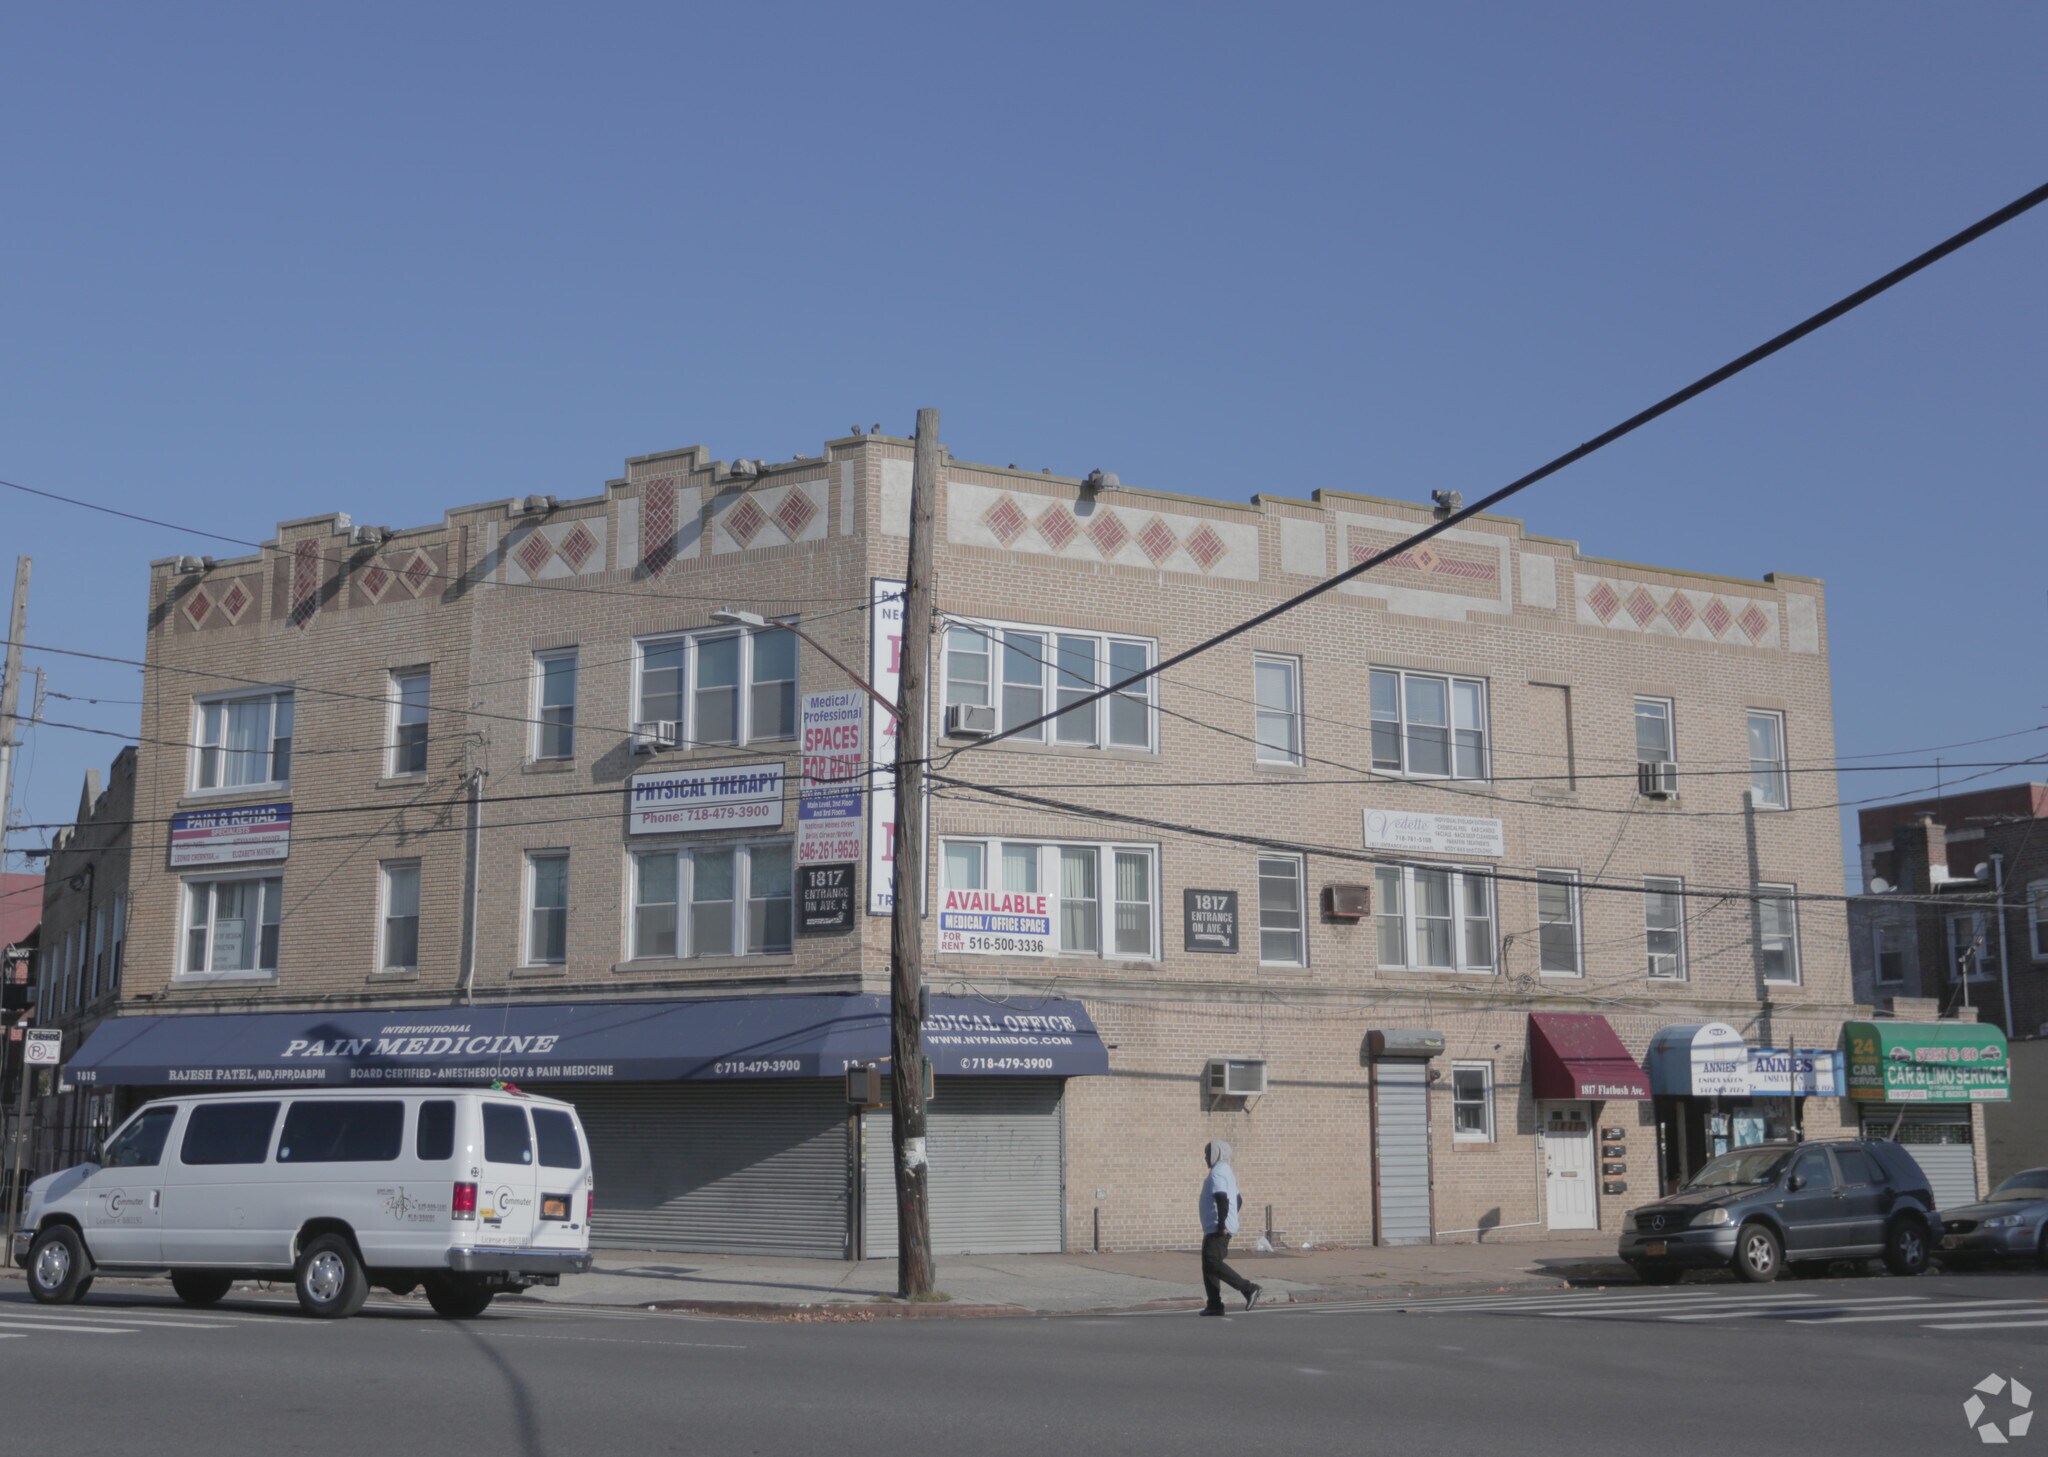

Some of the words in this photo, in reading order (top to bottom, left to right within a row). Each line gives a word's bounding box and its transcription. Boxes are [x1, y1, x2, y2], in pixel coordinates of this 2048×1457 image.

[810, 694, 848, 708] Medical
[803, 707, 862, 723] Professional
[806, 725, 859, 752] SPACES
[803, 755, 826, 786] FOR
[829, 753, 862, 784] RENT
[636, 778, 706, 801] PHYSICAL
[710, 772, 778, 796] THERAPY
[841, 799, 854, 807] Floor
[187, 815, 216, 829] PAIN
[231, 808, 277, 825] REHAB
[642, 811, 683, 824] Phone:
[687, 805, 769, 821] 718-479-3900
[211, 827, 250, 836] SPECIALISTS
[800, 840, 860, 861] 646-261-9628
[809, 870, 845, 887] 1817
[804, 887, 849, 900] ENTRANCE
[805, 900, 817, 911] ON
[820, 900, 839, 910] AVE.
[841, 899, 848, 910] K
[945, 890, 1047, 915] AVAILABLE
[1195, 895, 1229, 910] 1817
[945, 914, 983, 930] MEDICAL
[991, 916, 1019, 932] OFFICE
[1020, 918, 1046, 933] SPACE
[1191, 911, 1233, 923] ENTRANCE
[1192, 922, 1204, 933] ON
[1206, 923, 1224, 934] AVE.
[1226, 924, 1233, 934] K
[943, 932, 961, 941] FOR
[941, 941, 966, 951] RENT
[969, 937, 1044, 953] 516-500-3336
[381, 1024, 472, 1034] INTERVENTIONAL
[1003, 1015, 1077, 1033] OFFICE
[281, 1038, 372, 1057] PAIN
[370, 1035, 560, 1056] MEDICINE
[927, 1036, 1073, 1046] WWW.NYPAINDOC.COM
[1852, 1039, 1874, 1055] 24
[724, 1060, 800, 1073] 718-479-3900
[972, 1058, 1053, 1069] 718-479-3900
[1703, 1062, 1737, 1073] ANNIES
[1755, 1058, 1814, 1073] ANNIES
[1852, 1065, 1876, 1076] CAR
[168, 1069, 213, 1081] RAJESH
[216, 1069, 257, 1081] PATEL,
[350, 1068, 383, 1078] BOARD
[384, 1068, 431, 1078] CERTIFIED
[437, 1067, 526, 1078] ANESTHESIOLOGY
[527, 1067, 535, 1077] &
[536, 1067, 560, 1077] PAIN
[562, 1065, 614, 1076] MEDICINE
[1887, 1066, 1914, 1085] CAR
[1916, 1066, 1925, 1085] &
[1926, 1067, 1955, 1085] LIMO
[1956, 1067, 2006, 1085] SERVICE
[1849, 1077, 1884, 1086] SERVICE
[1581, 1085, 1596, 1095] 1817
[1598, 1085, 1629, 1095] Flatbush
[1631, 1085, 1646, 1095] Ave.
[112, 1195, 144, 1210] Commuter
[500, 1193, 532, 1209] Commuter
